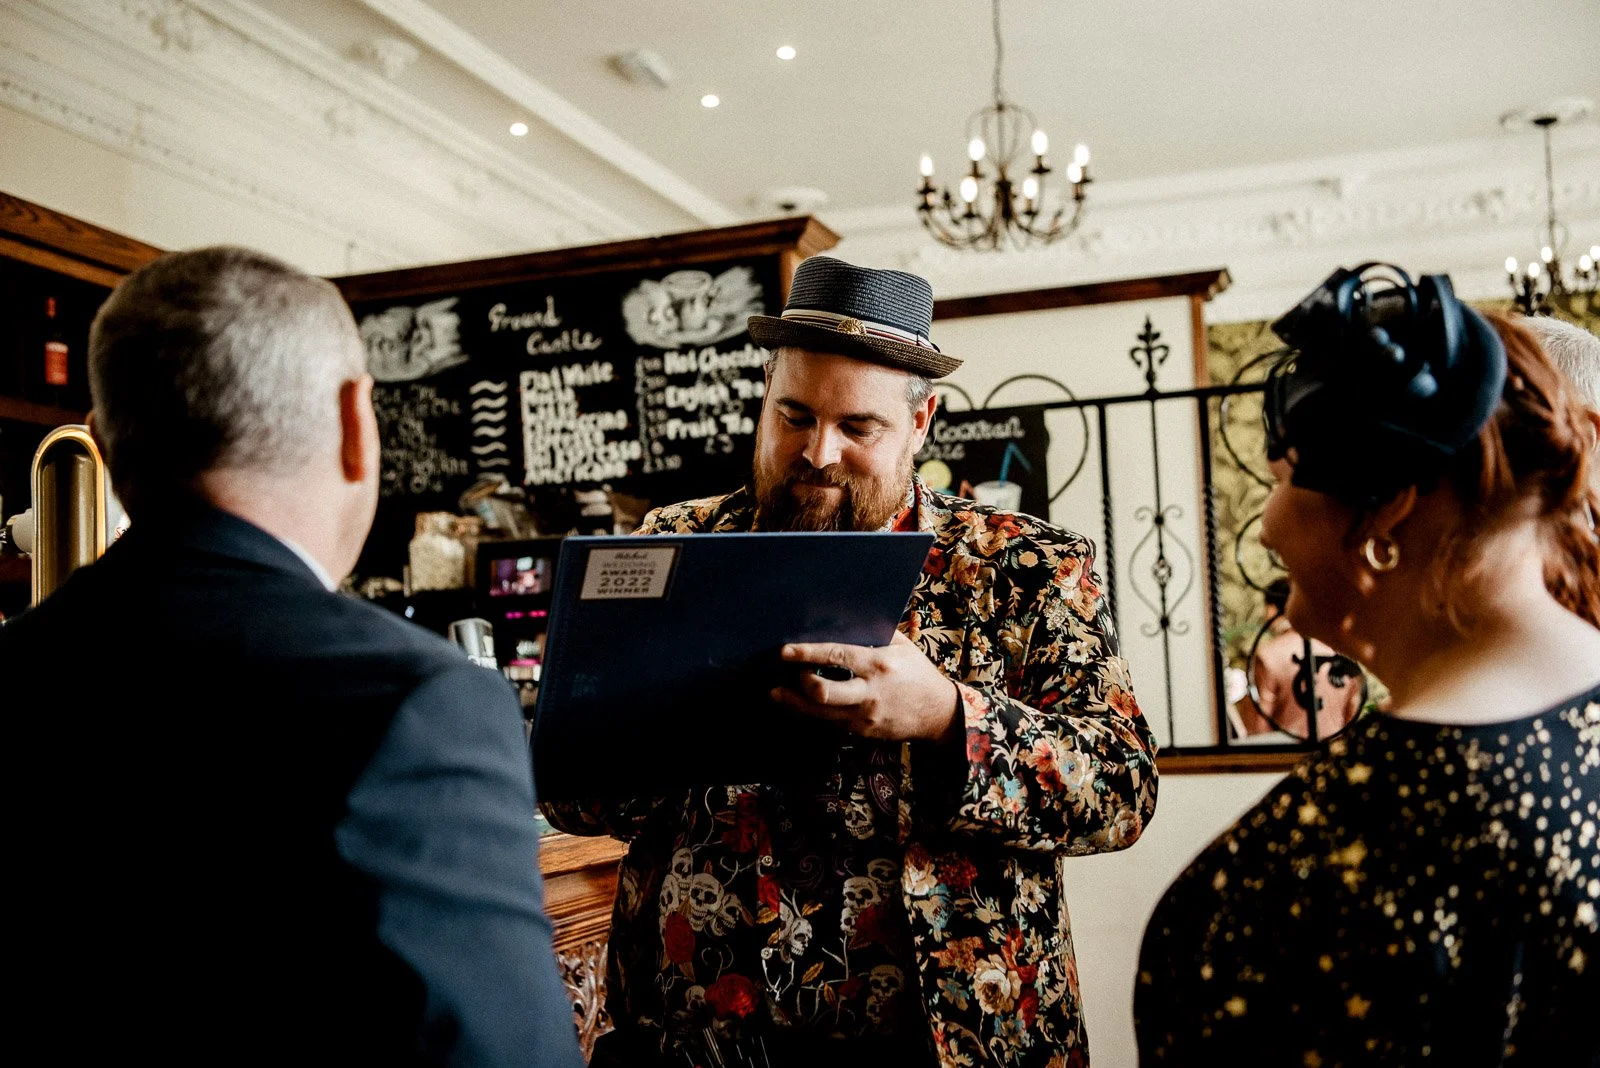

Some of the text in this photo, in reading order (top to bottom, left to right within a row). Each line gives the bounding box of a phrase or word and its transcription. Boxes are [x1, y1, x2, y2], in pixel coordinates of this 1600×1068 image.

[600, 568, 655, 577] AWARDS
[600, 577, 652, 587] 2022
[597, 587, 650, 595] WINNER
